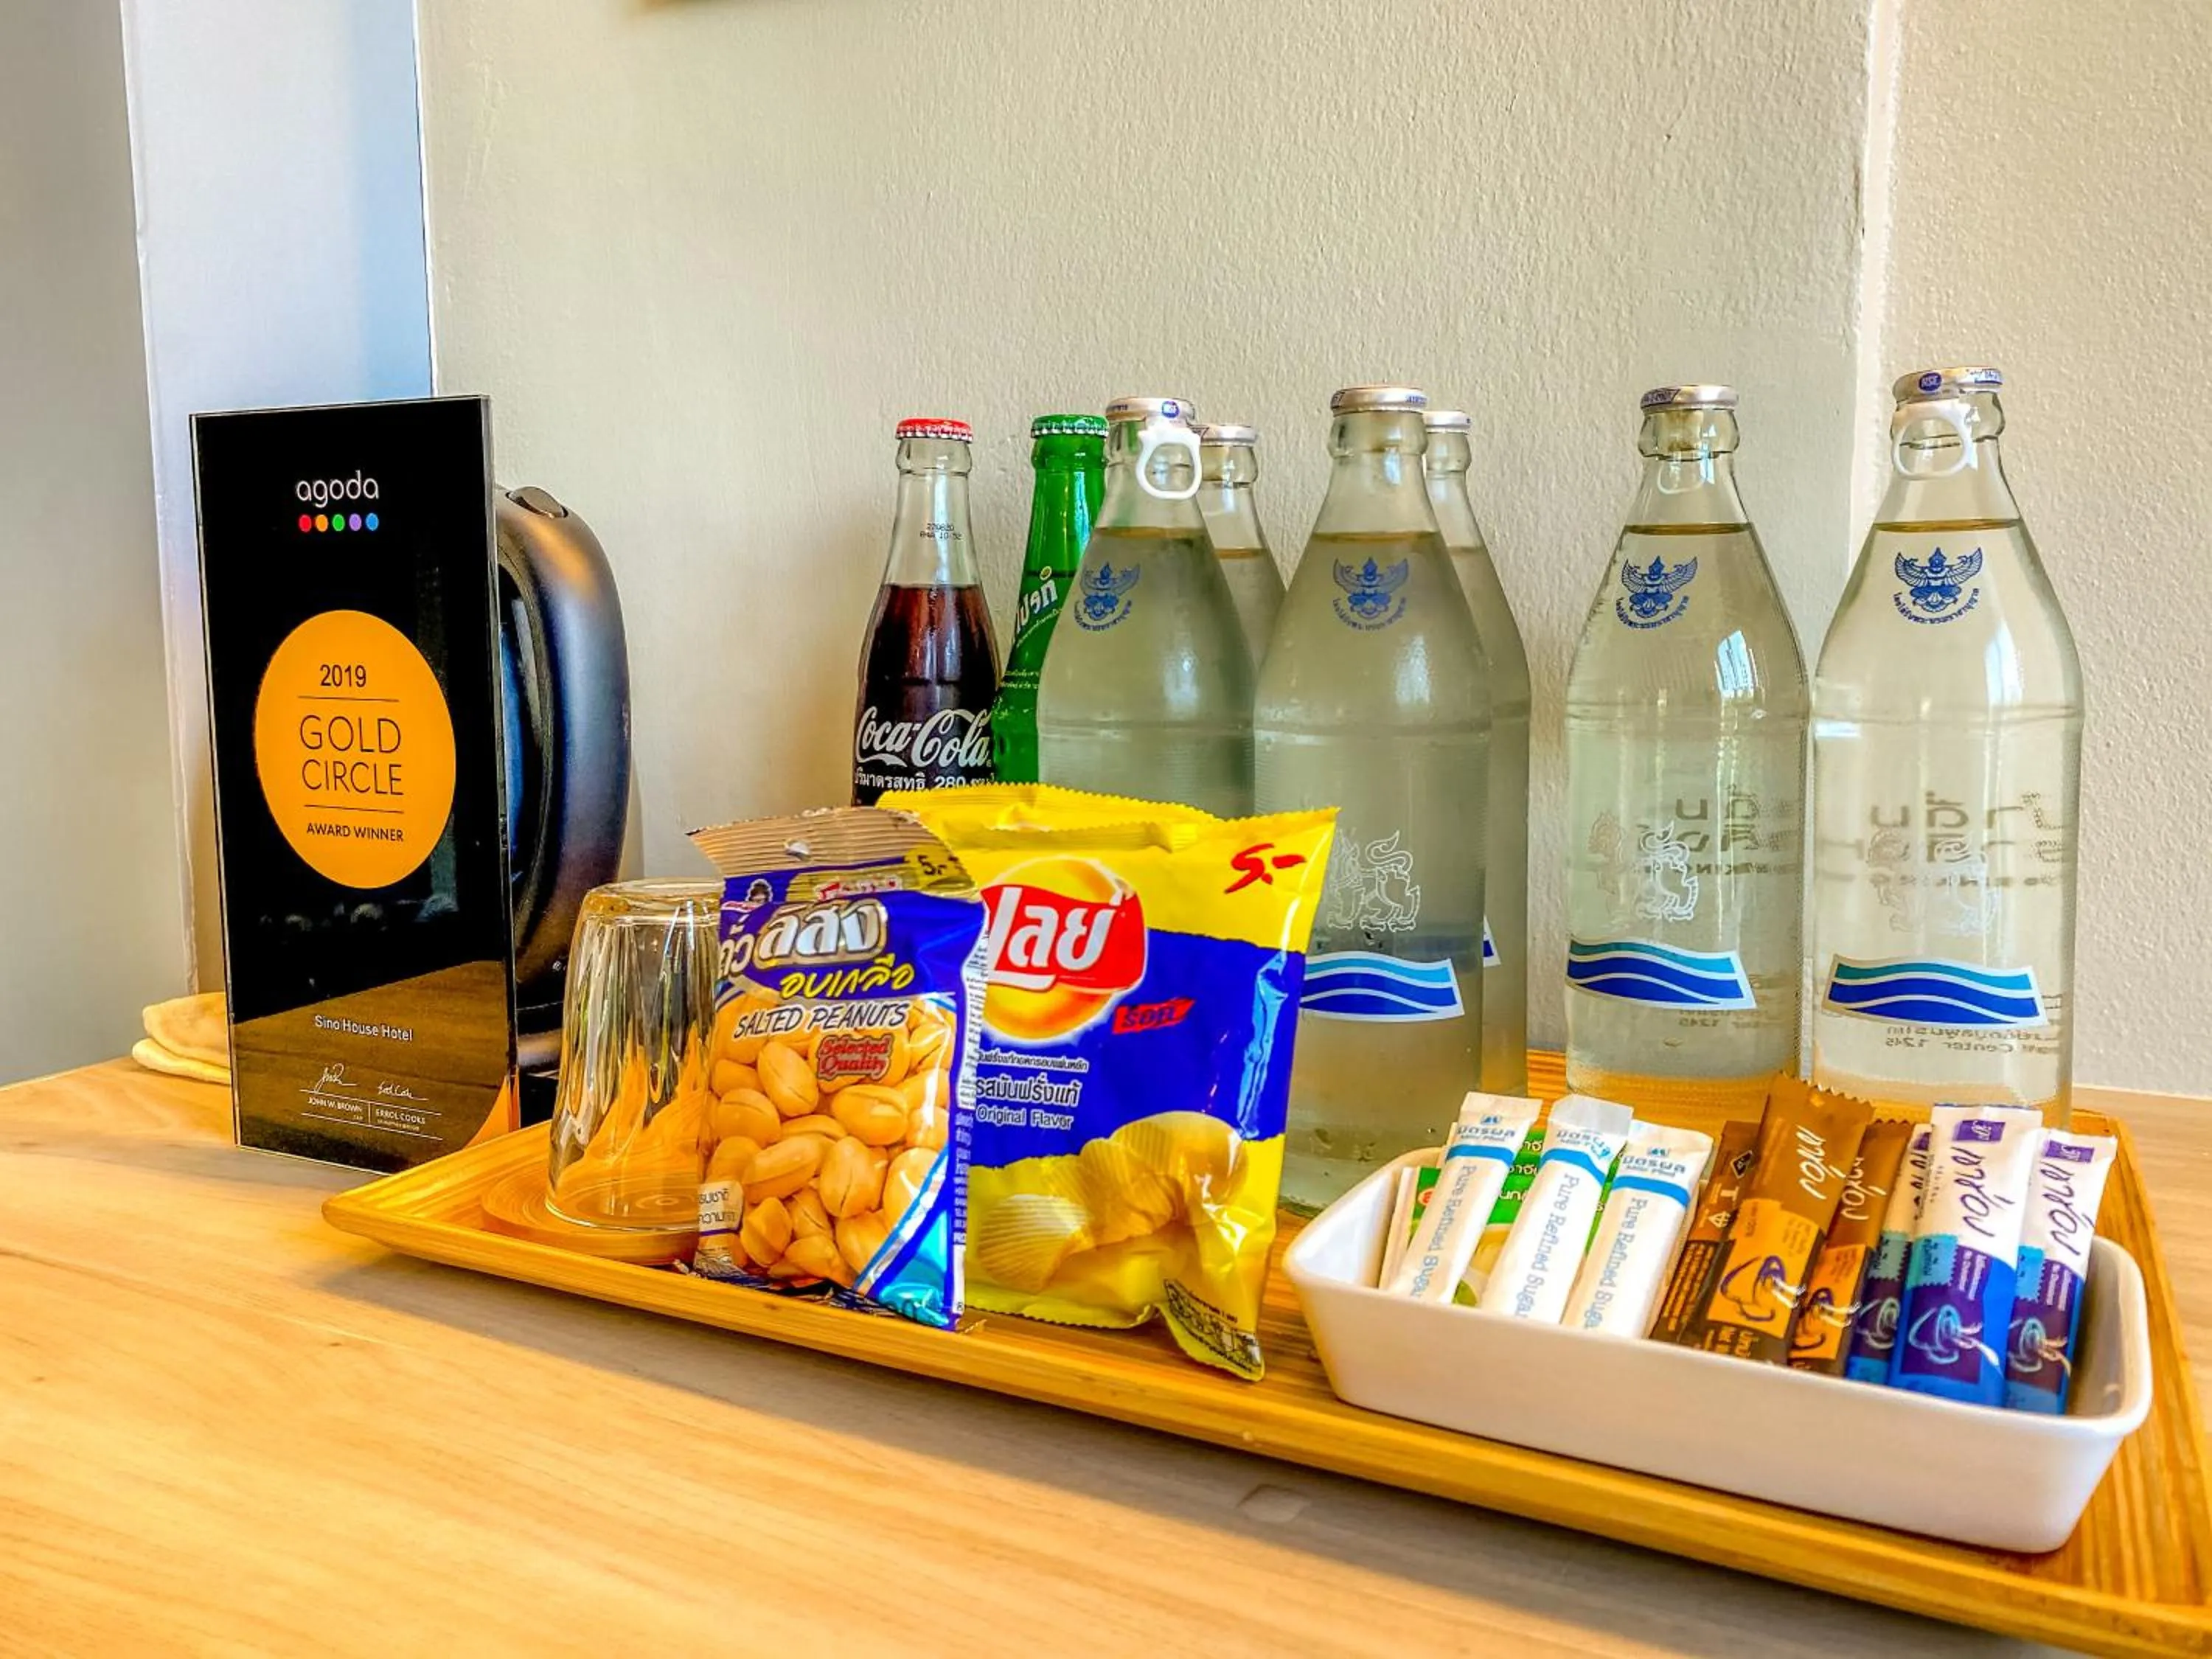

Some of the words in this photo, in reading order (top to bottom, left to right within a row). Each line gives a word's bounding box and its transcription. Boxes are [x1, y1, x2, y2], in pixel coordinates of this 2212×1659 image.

[296, 470, 379, 507] agoda
[320, 664, 366, 688] 2019
[299, 715, 402, 754] GOLD
[855, 705, 992, 768] Coca-Cola
[302, 759, 405, 796] CIRCLE
[933, 776, 967, 789] 280
[306, 822, 352, 838] AWARD
[354, 825, 405, 843] WINNER
[779, 953, 915, 1000] อบเกลือ
[315, 1014, 341, 1030] Sino
[342, 1018, 379, 1037] House
[381, 1024, 414, 1042] Hotel
[734, 1007, 804, 1039] SALTED
[807, 1004, 909, 1031] PEANUTS
[821, 1034, 889, 1054] Selected
[818, 1055, 887, 1079] Quality
[336, 1101, 363, 1113] BROWN
[977, 1105, 1026, 1127] Original
[1032, 1110, 1074, 1130] Flavor
[1452, 1164, 1478, 1199] Pure
[1556, 1172, 1580, 1211] Pure
[1427, 1196, 1463, 1251] Refined
[1621, 1197, 1648, 1230] Pure
[1531, 1212, 1566, 1276] Refined
[1599, 1231, 1635, 1289] Refined
[1583, 1290, 1613, 1329] Suga
